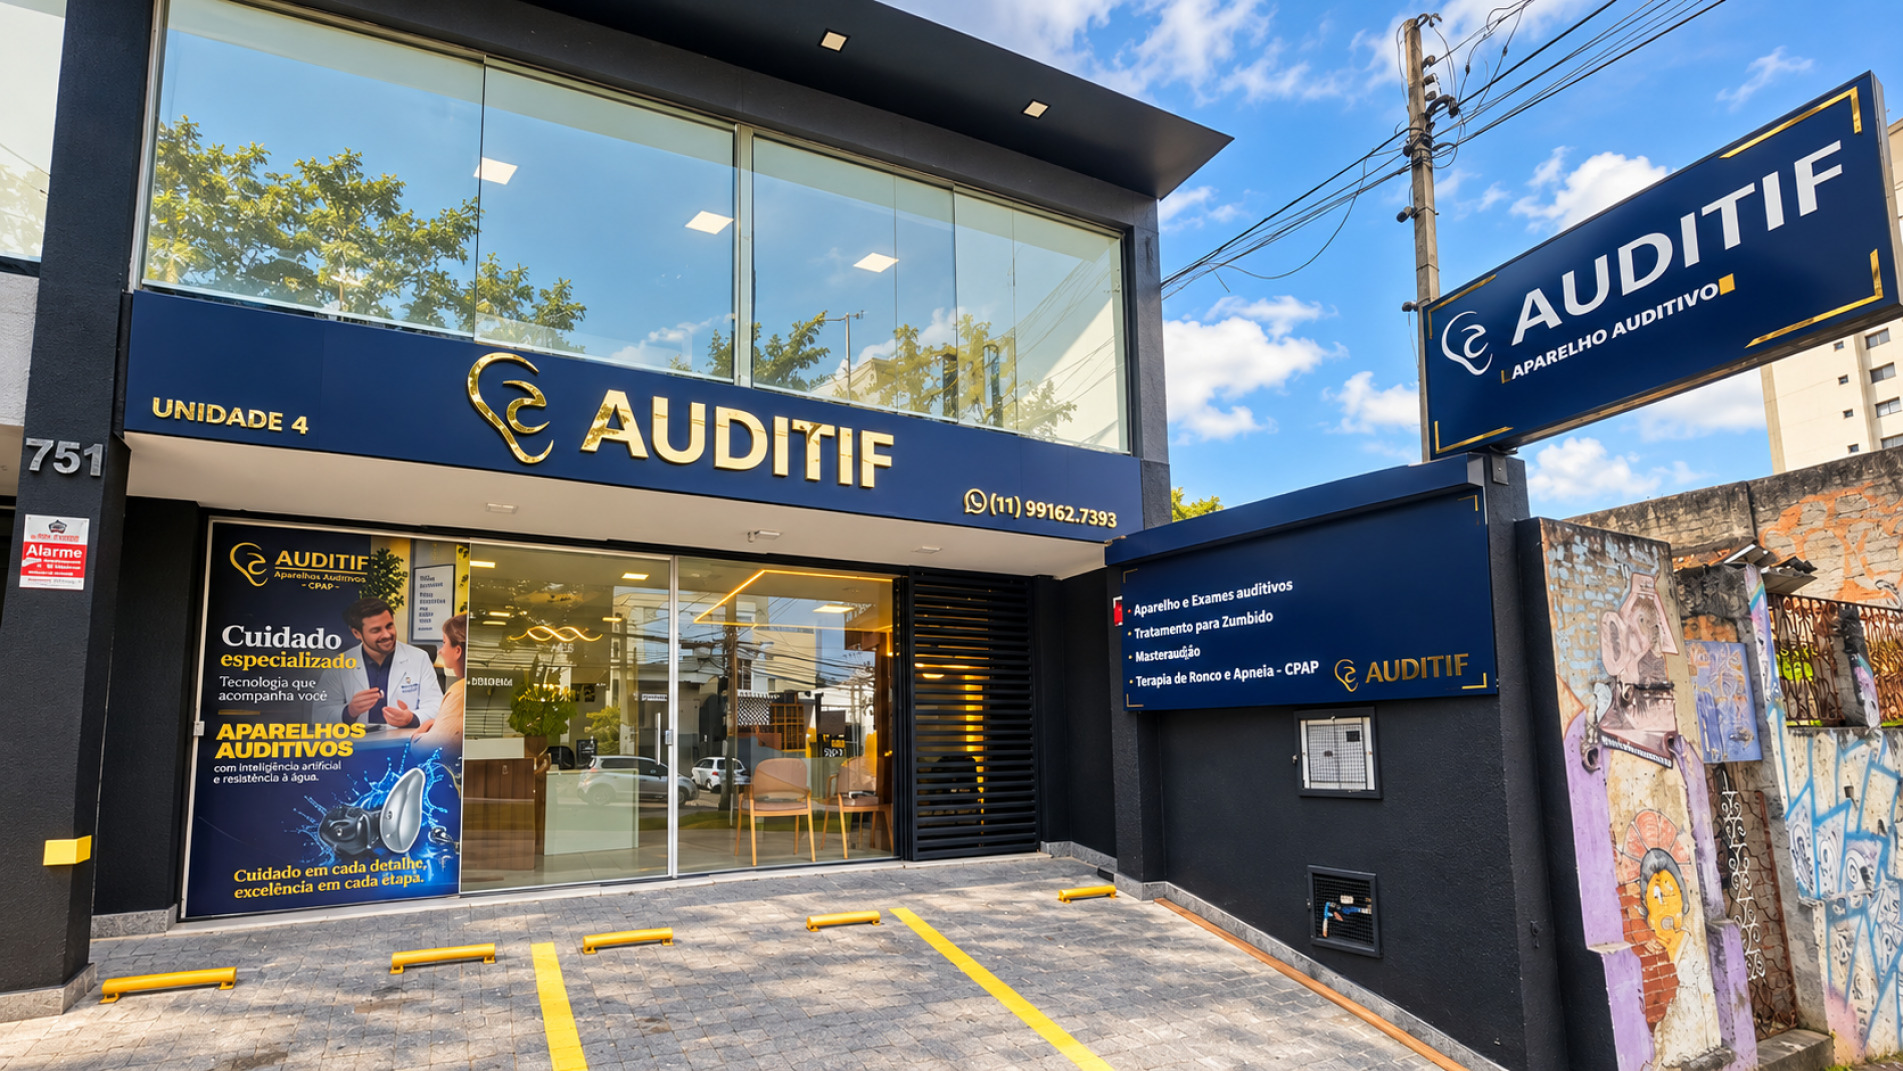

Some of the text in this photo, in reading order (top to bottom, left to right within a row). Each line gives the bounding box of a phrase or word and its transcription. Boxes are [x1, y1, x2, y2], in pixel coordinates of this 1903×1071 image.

[1511, 140, 1843, 346] AUDITIF
[1511, 282, 1719, 380] APARELHO AUDITIVO
[152, 396, 309, 435] UNIDADE 4
[580, 388, 895, 489] AUDITIF
[25, 437, 104, 478] 751
[990, 492, 1118, 529] (11) 99162.7393
[26, 543, 83, 559] Alarme
[274, 550, 370, 571] AUDITIF
[273, 570, 321, 581] Aparelhos
[1134, 580, 1294, 619] Aparelho e Exames auditivos
[221, 624, 342, 650] Cuidado
[1134, 610, 1274, 640] Tratamento para Zumbido
[220, 650, 358, 672] especializado
[1365, 653, 1469, 684] AUDITIF
[219, 675, 317, 691] Tecnologia que
[1136, 672, 1172, 689] Terapia
[1174, 671, 1188, 685] de
[1189, 669, 1222, 683] Ronco
[1224, 669, 1231, 680] e
[1233, 664, 1275, 683] Apneia
[1284, 660, 1320, 676] CPAP
[218, 691, 295, 704] acompanha
[215, 722, 367, 740] APARELHOS
[214, 740, 354, 759] AUDITIVOS
[213, 764, 237, 774] com
[213, 776, 221, 785] e
[233, 865, 302, 883] Cuidado
[305, 865, 329, 878] em
[331, 860, 367, 876] cada
[233, 880, 314, 899] excelência
[317, 881, 341, 892] em
[344, 874, 379, 890] cada
